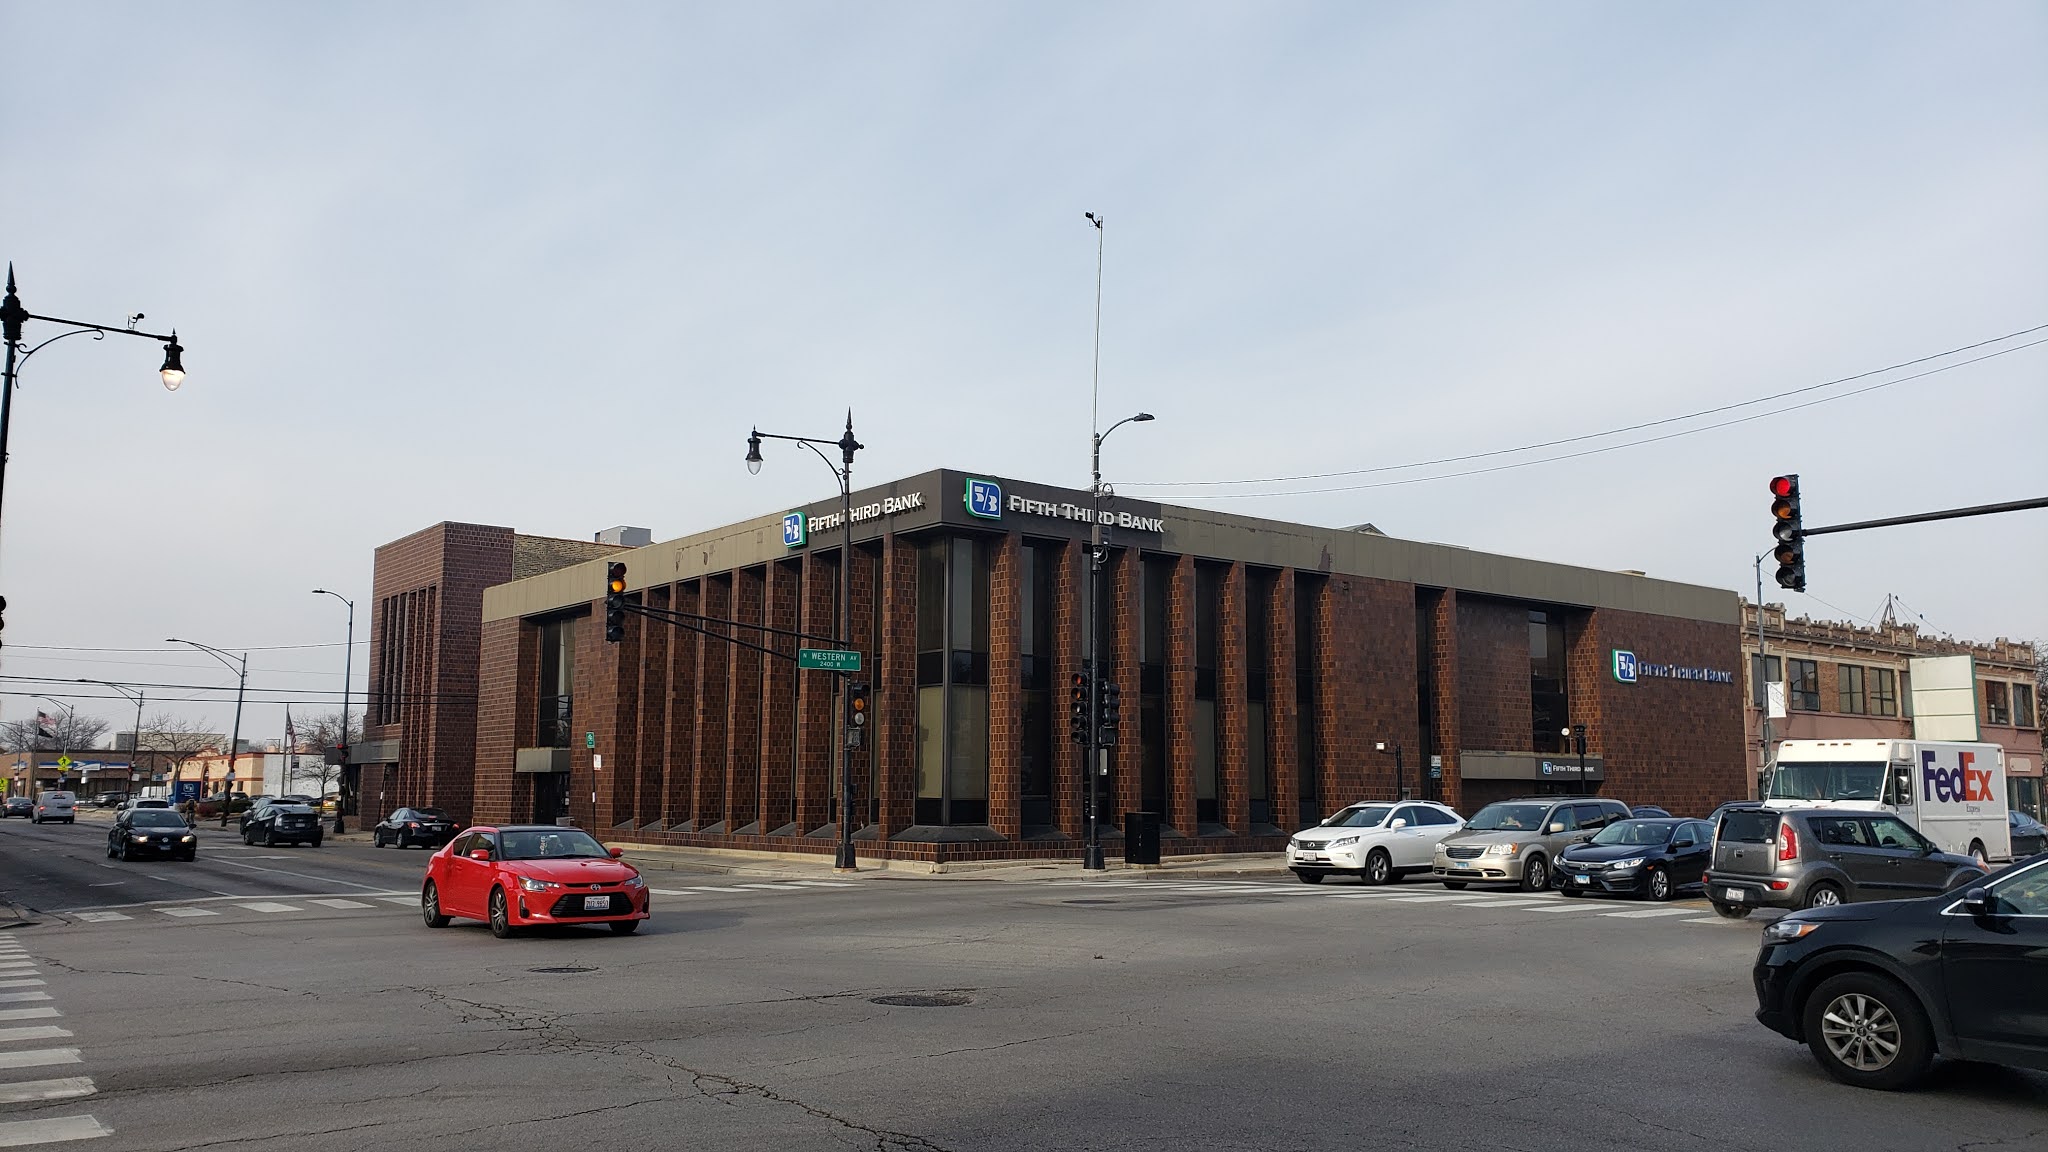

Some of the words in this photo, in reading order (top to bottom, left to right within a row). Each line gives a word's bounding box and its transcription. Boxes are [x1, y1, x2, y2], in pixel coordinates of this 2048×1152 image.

[808, 513, 840, 533] FIFTH
[842, 502, 880, 523] HIRD
[883, 492, 922, 514] BANK
[1009, 494, 1058, 518] FIFTH
[1118, 511, 1165, 533] BANK
[811, 652, 846, 661] WESTERN
[1552, 764, 1566, 772] FIFTH
[1921, 750, 1995, 803] FedEx
